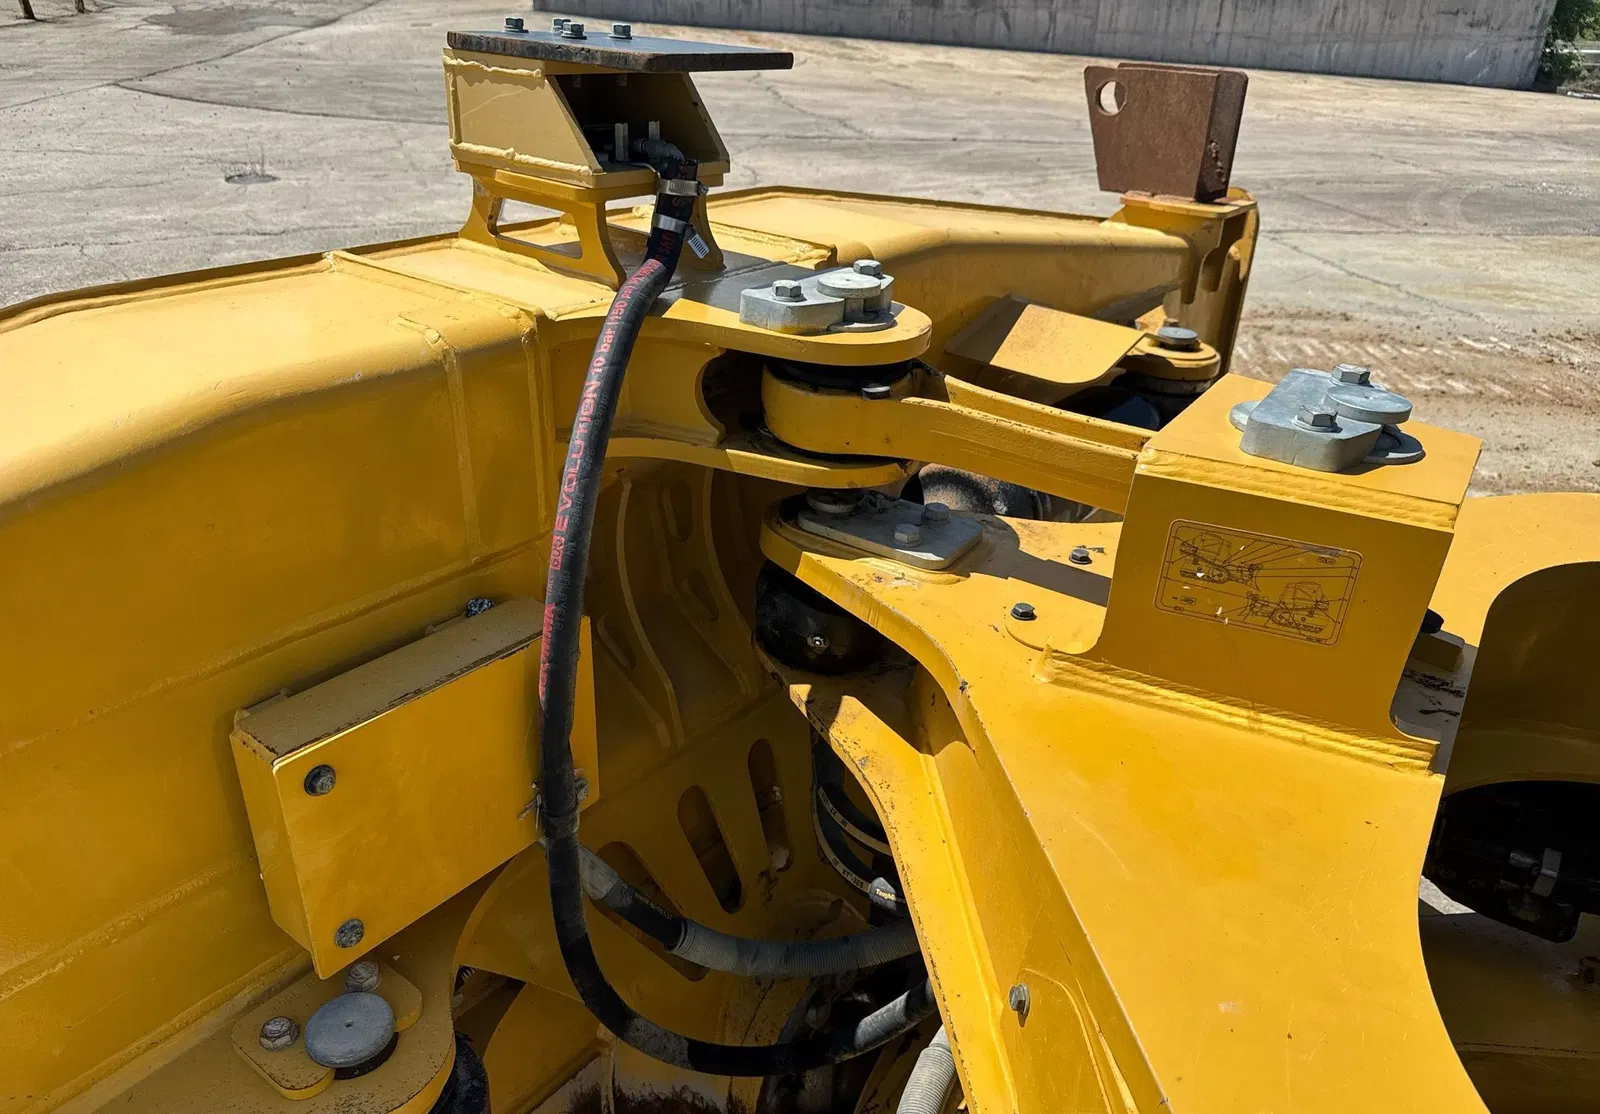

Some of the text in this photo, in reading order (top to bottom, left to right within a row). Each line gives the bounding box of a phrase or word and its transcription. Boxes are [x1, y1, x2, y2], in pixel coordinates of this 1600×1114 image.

[598, 328, 615, 353] bar
[591, 356, 606, 375] 10
[555, 381, 600, 531] EVOLUTION
